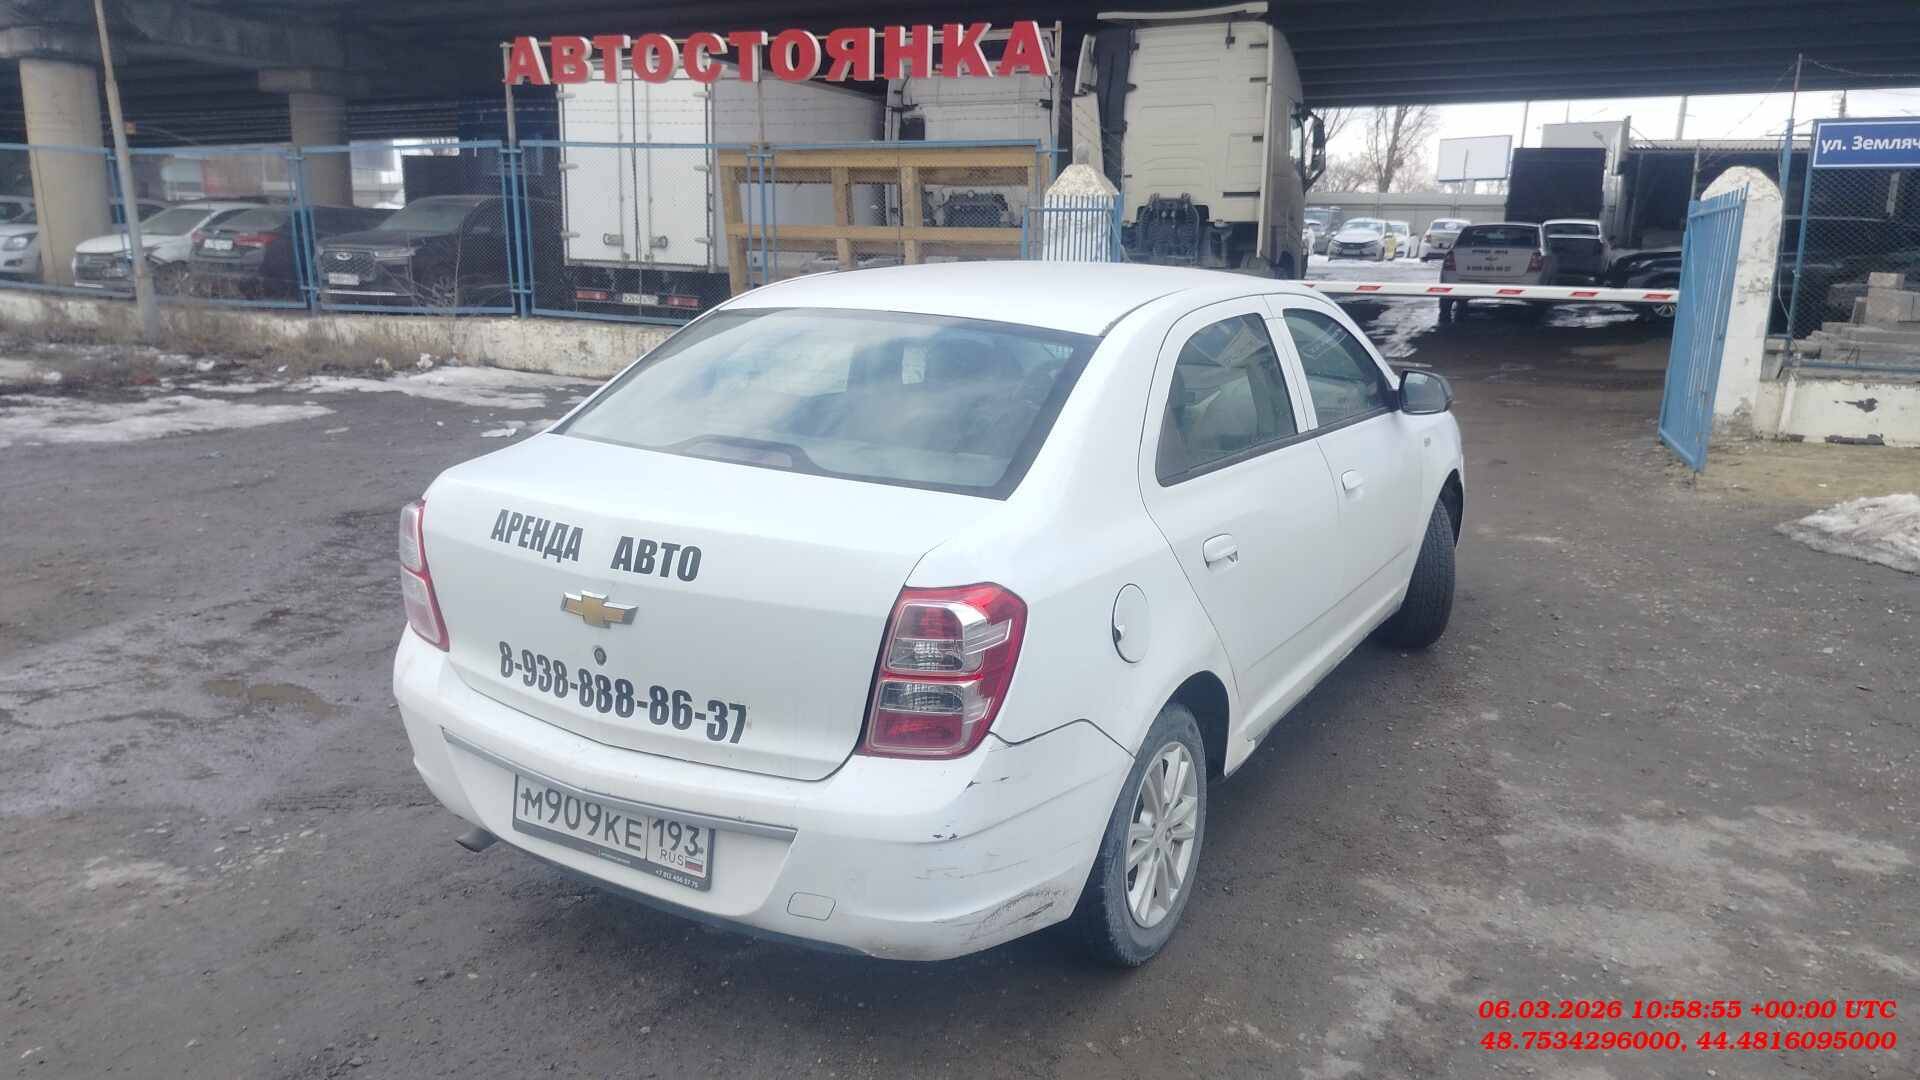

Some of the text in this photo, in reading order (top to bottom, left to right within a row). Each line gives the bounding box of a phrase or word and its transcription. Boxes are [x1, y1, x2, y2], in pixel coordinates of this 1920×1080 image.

[505, 20, 1053, 85] АВТОСТОЯНКА
[1821, 138, 1847, 154] ул.
[490, 508, 702, 582] АРЕНДА АВТО
[499, 640, 747, 744] 8-938-888-86-37
[653, 818, 701, 857] 193
[659, 848, 685, 866] RUS
